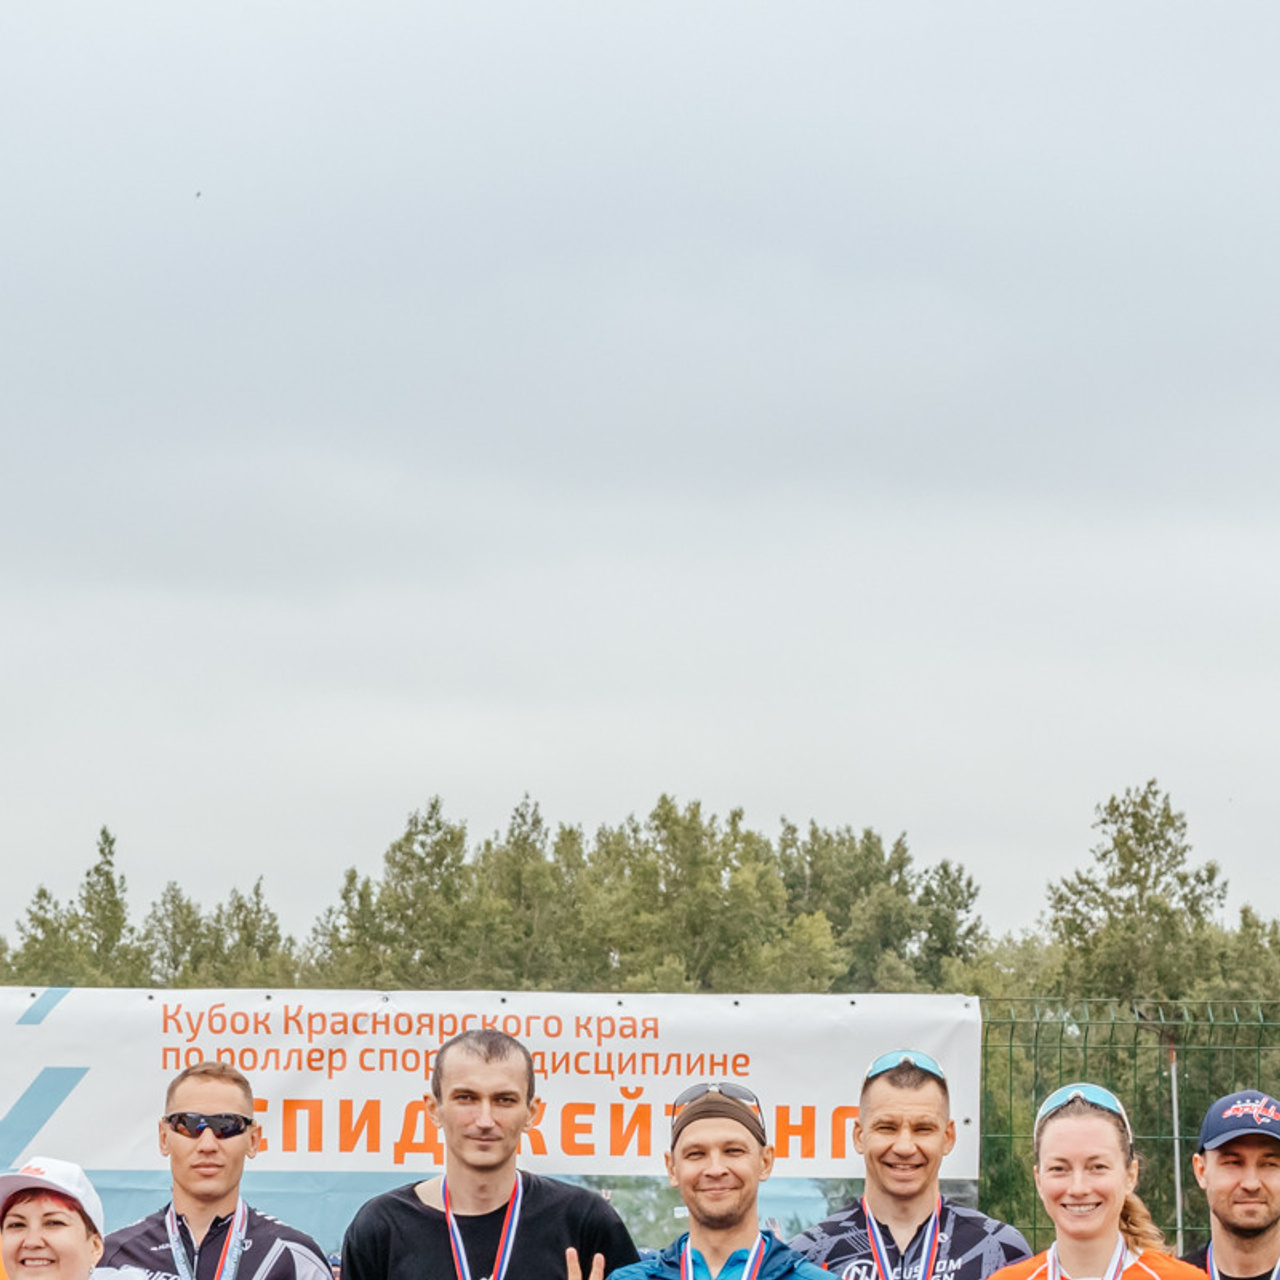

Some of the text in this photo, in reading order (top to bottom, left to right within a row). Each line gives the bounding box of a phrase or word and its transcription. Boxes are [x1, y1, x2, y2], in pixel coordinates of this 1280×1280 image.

[162, 1003, 271, 1042] Кубок
[575, 1015, 660, 1047] края
[359, 1048, 437, 1081] спор
[892, 1257, 963, 1280] CUSOM
